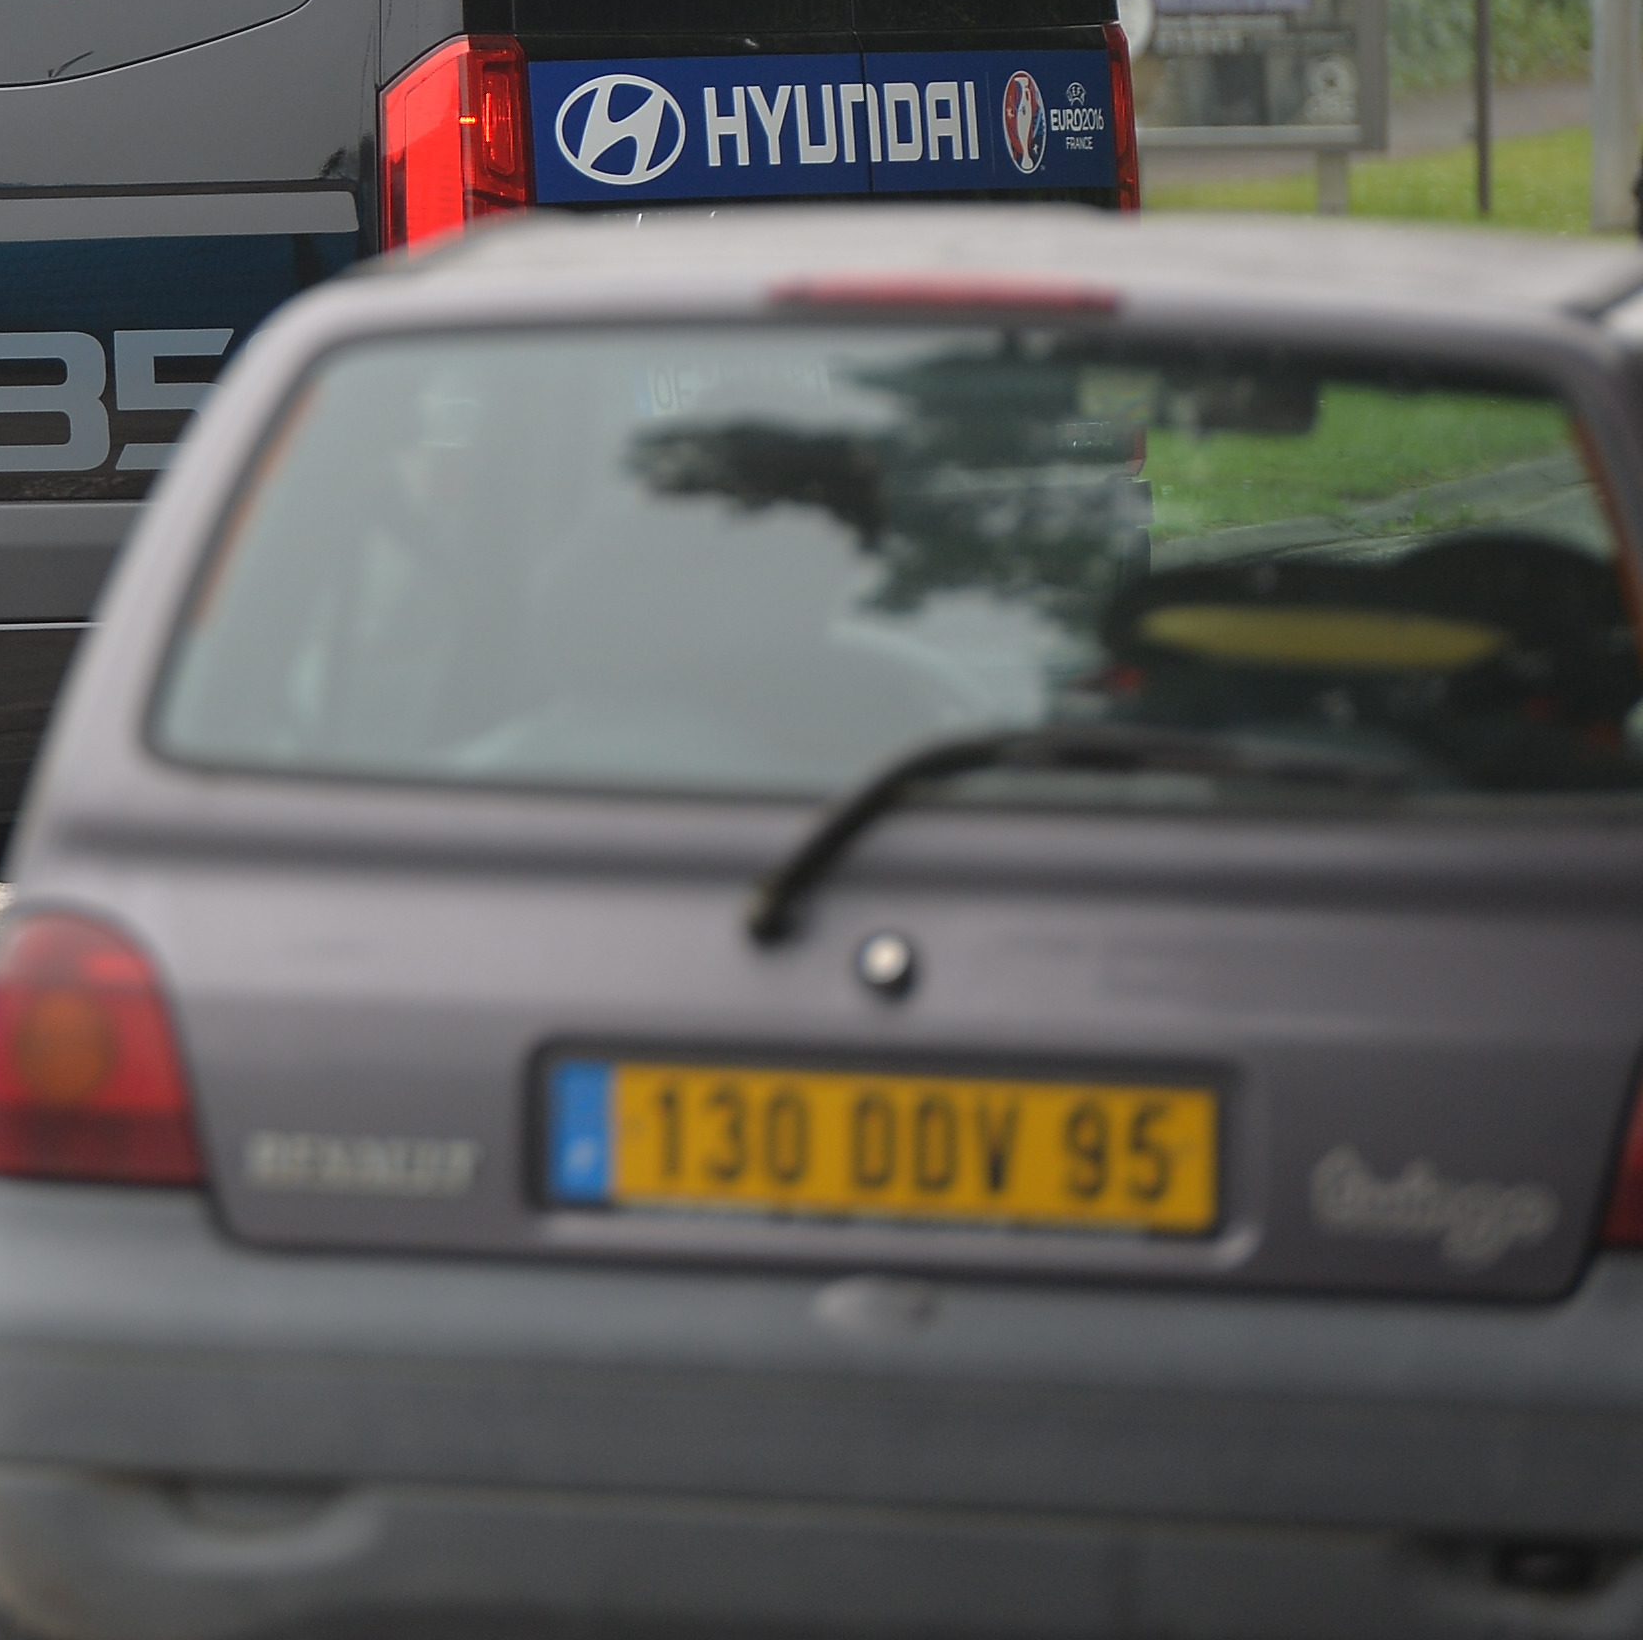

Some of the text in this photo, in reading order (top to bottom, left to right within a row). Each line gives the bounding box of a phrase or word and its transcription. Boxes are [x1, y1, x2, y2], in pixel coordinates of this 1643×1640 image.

[703, 81, 979, 167] HYUNDAI
[1065, 136, 1094, 150] FRANCE
[655, 1077, 1174, 1203] 130 DDV 95
